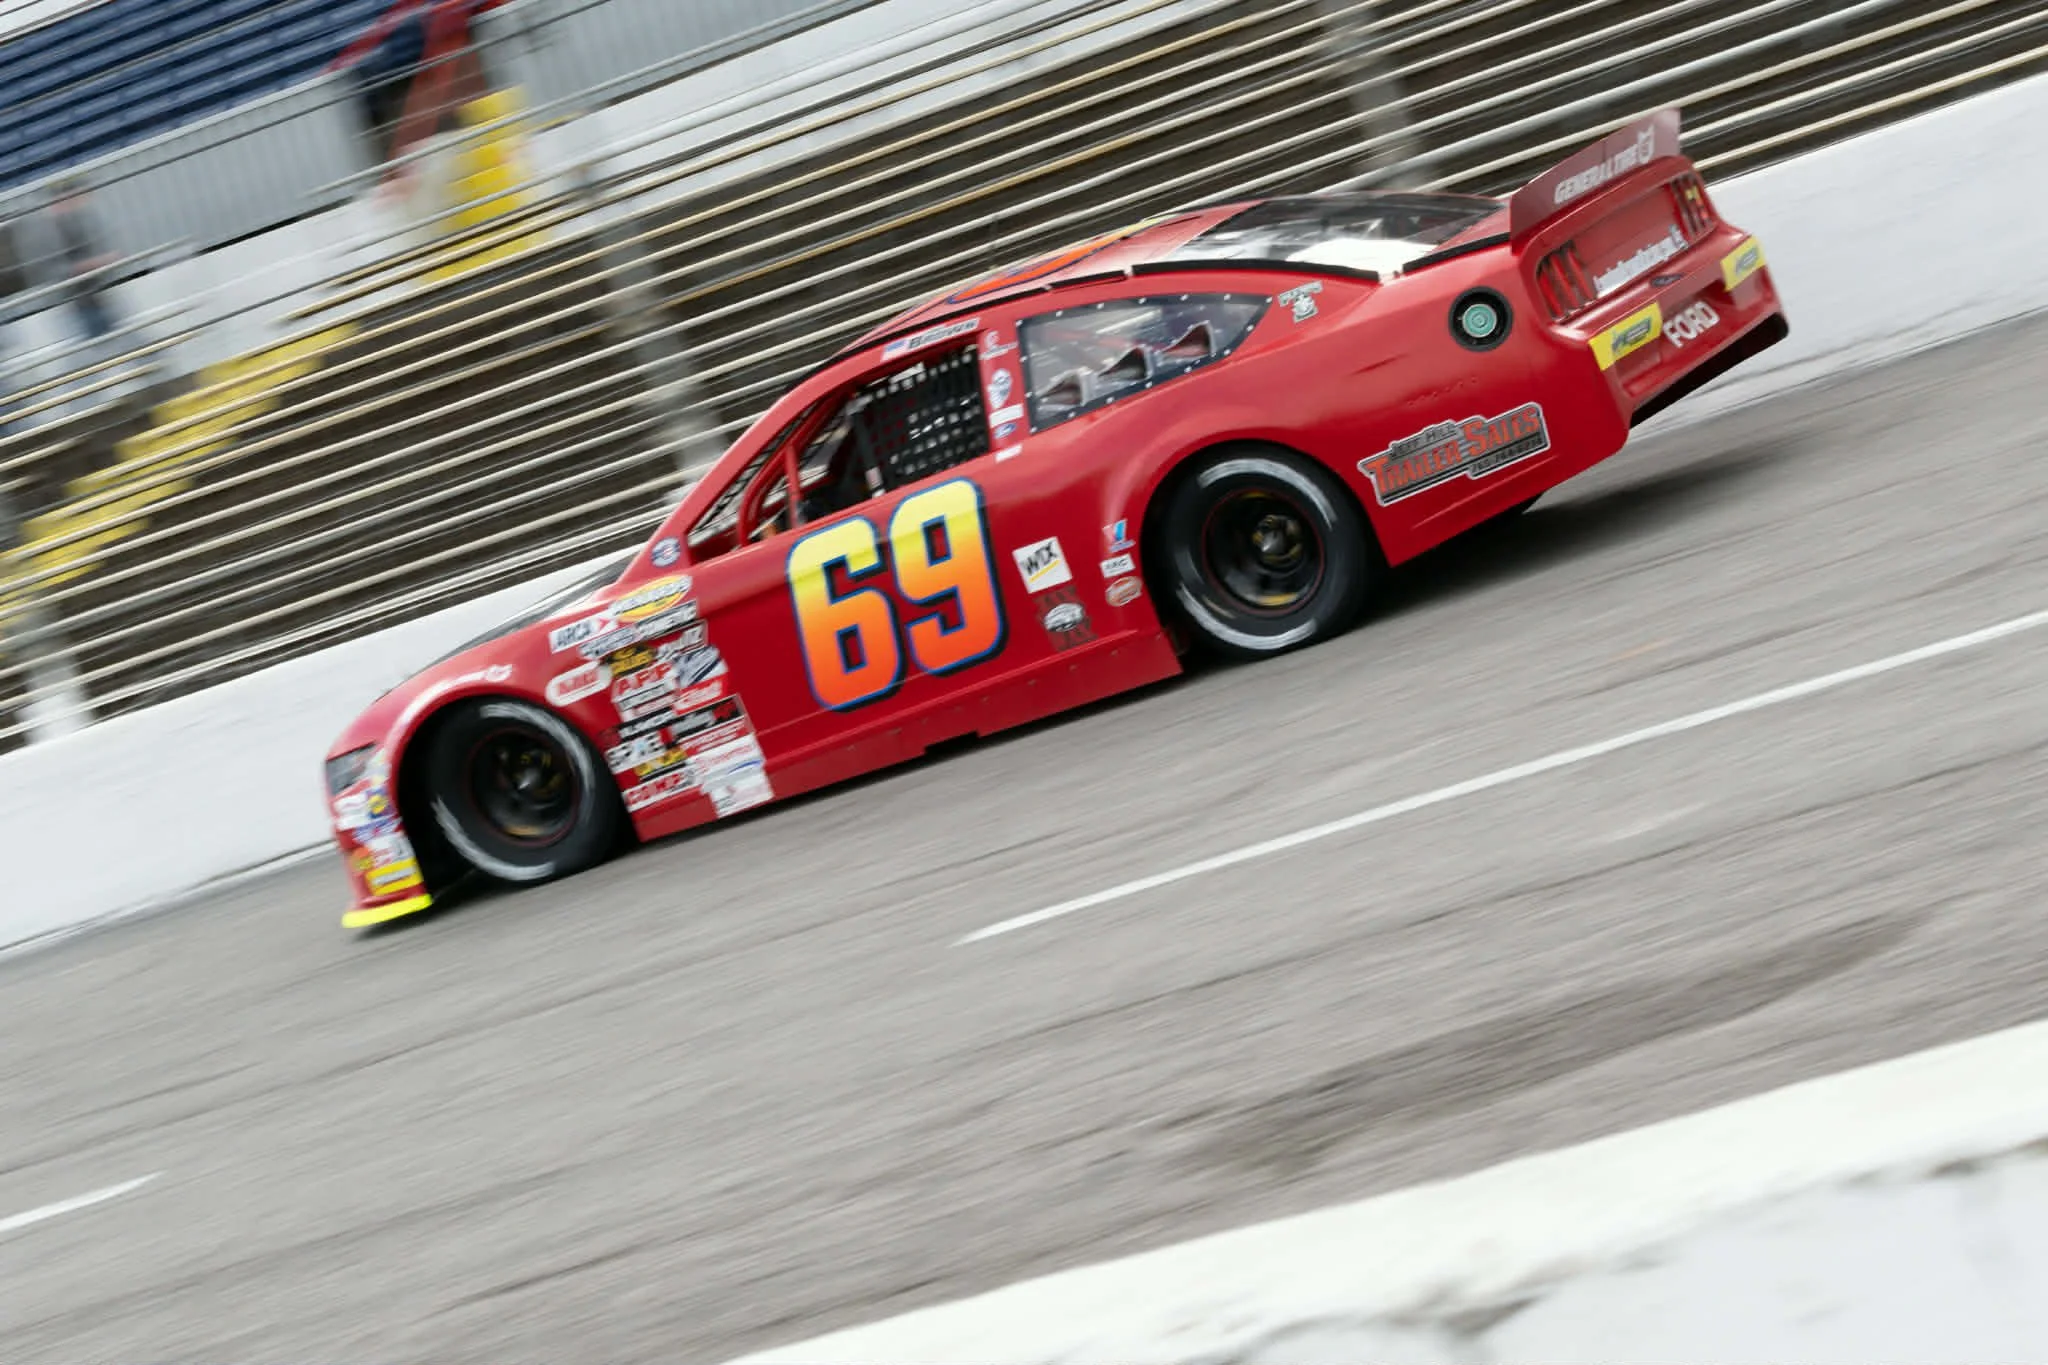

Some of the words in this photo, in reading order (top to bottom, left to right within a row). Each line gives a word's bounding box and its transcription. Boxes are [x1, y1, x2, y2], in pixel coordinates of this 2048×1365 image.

[1555, 157, 1615, 204] GENERAL
[1663, 301, 1720, 348] FORD
[1366, 437, 1464, 495] TRAILER
[1462, 407, 1541, 457] SALES
[1022, 541, 1058, 576] WIX
[785, 476, 1009, 714] 69
